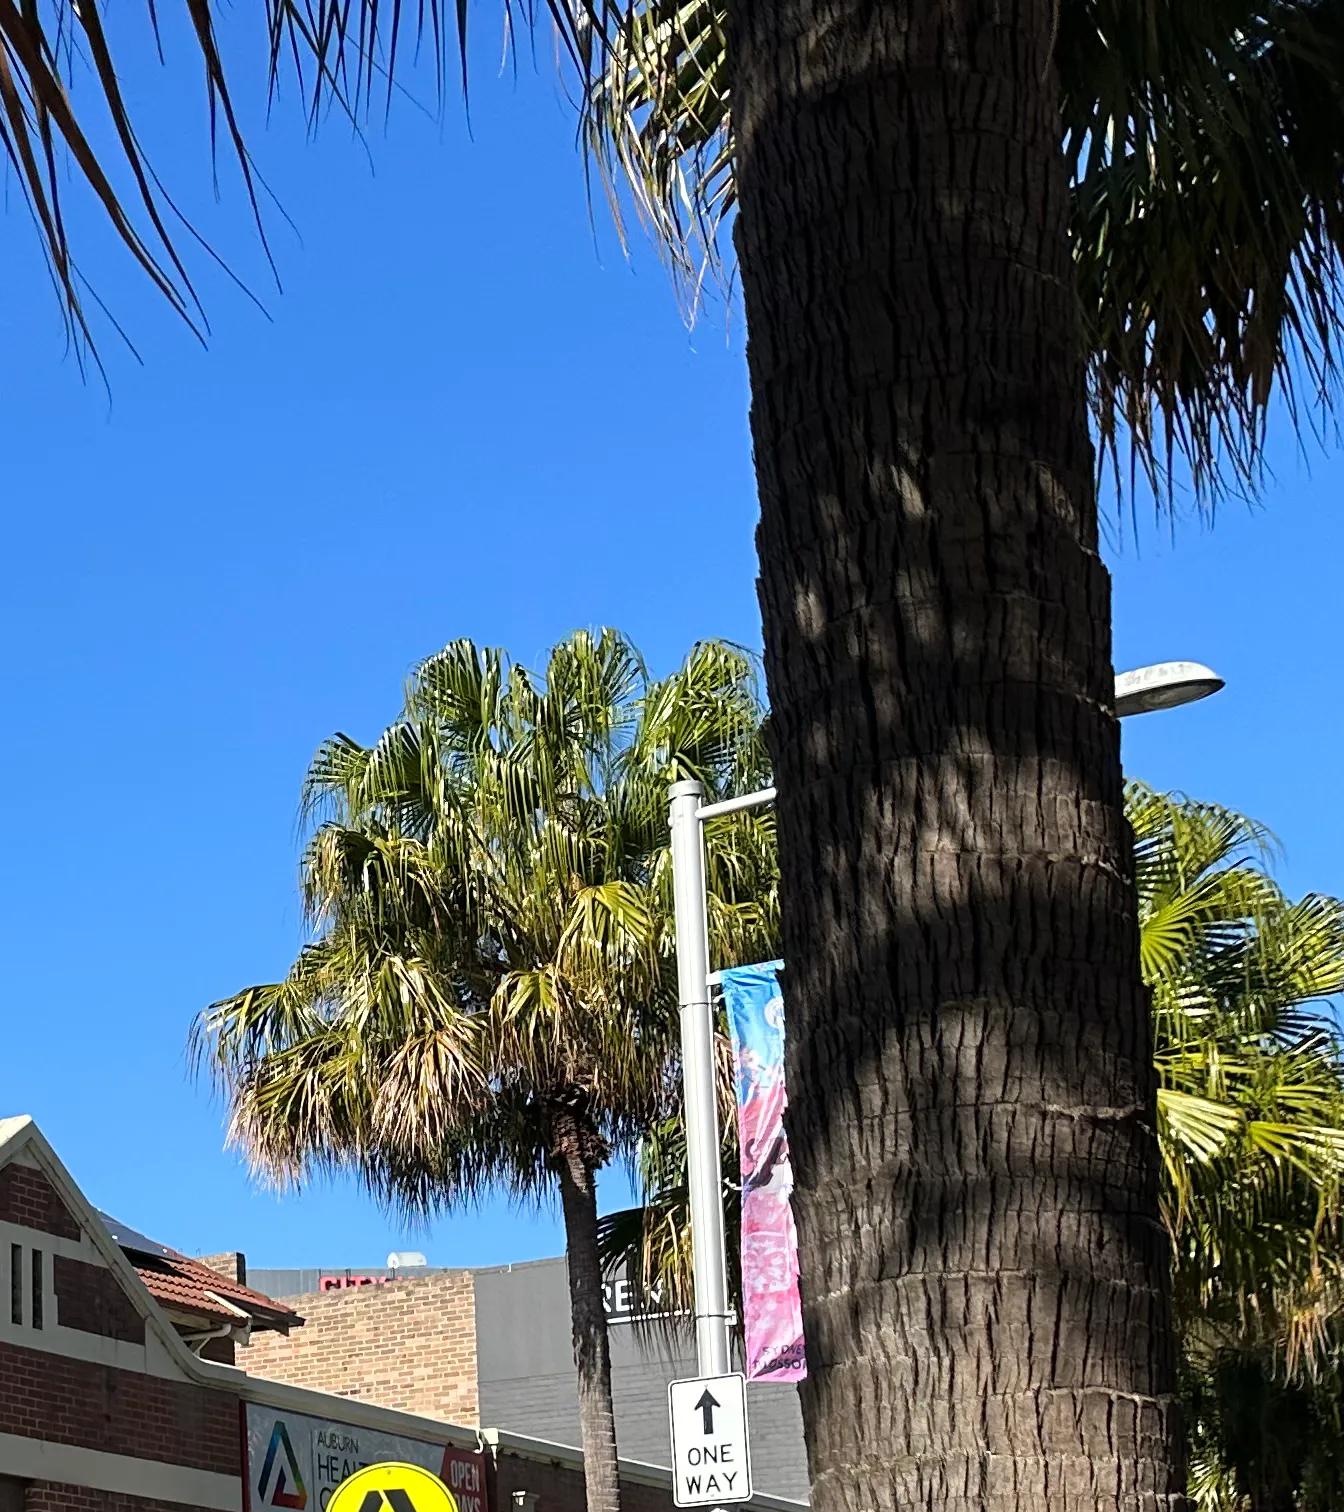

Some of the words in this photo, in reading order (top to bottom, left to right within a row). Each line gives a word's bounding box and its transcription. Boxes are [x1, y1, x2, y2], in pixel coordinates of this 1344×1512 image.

[316, 1431, 360, 1454] AUBURN
[687, 1443, 734, 1466] ONE
[449, 1459, 480, 1493] OPEN
[686, 1471, 738, 1495] WAY
